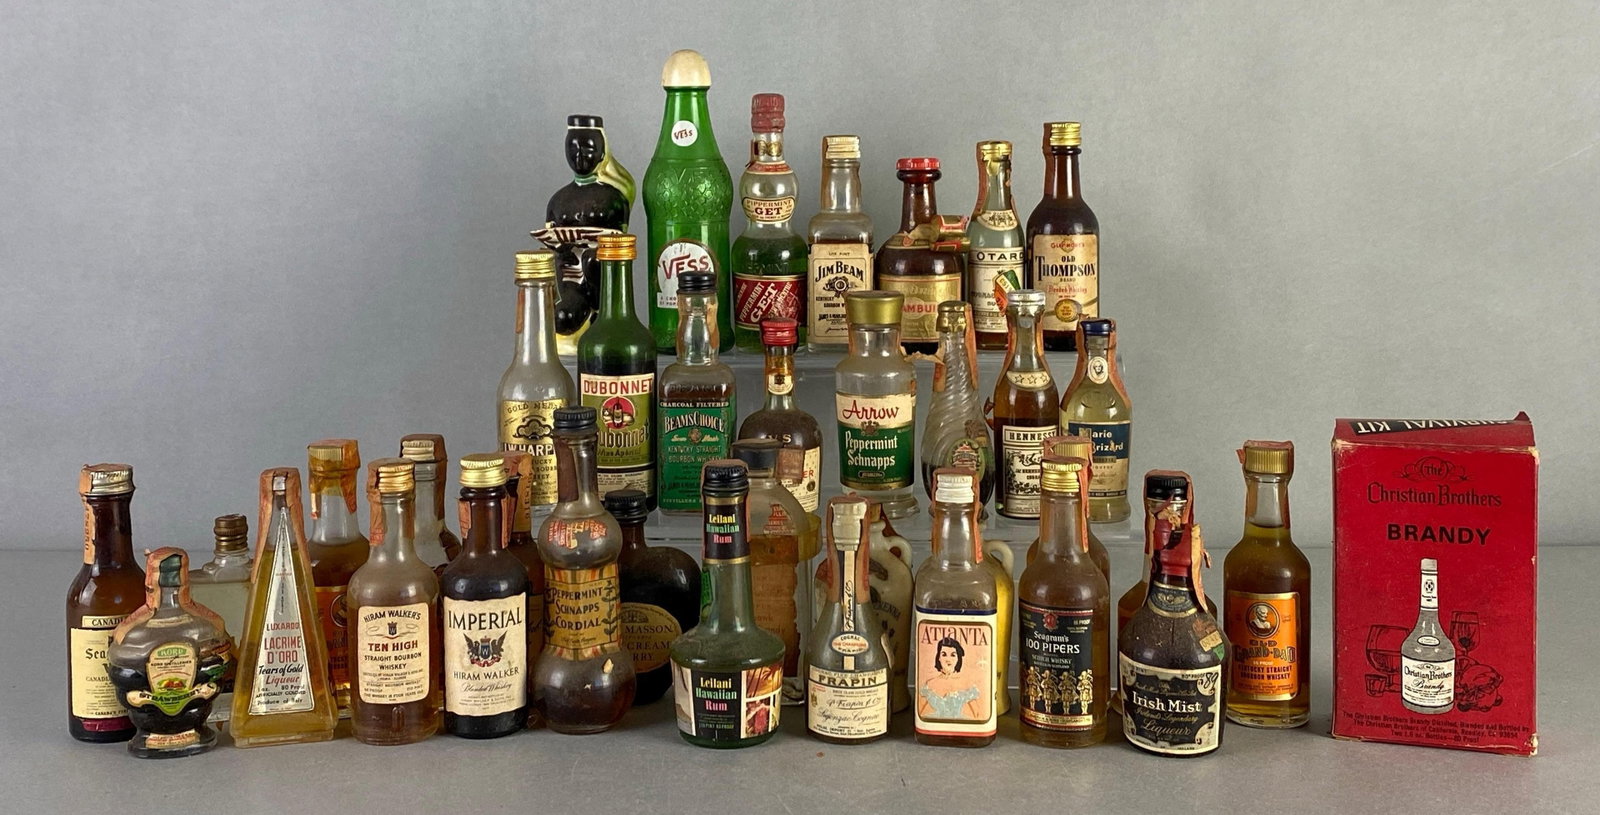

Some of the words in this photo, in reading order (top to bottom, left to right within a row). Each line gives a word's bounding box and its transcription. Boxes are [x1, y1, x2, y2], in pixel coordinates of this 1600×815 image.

[674, 129, 693, 140] VESS
[754, 207, 783, 216] GET
[662, 253, 709, 279] VESS
[815, 265, 834, 282] JIM
[836, 261, 864, 282] BEAM
[1035, 256, 1096, 281] THOMPSON
[751, 283, 778, 322] GET
[902, 304, 936, 313] AMBUI
[584, 378, 652, 394] DUBONNET
[507, 403, 529, 413] GOLD
[843, 400, 899, 419] Arrow
[1358, 421, 1391, 434] KIT
[1398, 419, 1507, 430] VIVAL
[597, 418, 649, 449] ubonnet
[845, 430, 898, 452] Peppermint
[847, 449, 896, 470] Schnapps
[1425, 465, 1443, 476] The
[1368, 482, 1436, 504] Christian
[1438, 485, 1502, 507] Brothers
[709, 514, 736, 523] Leilani
[706, 524, 740, 533] Hawaiian
[1388, 524, 1491, 545] BRANDY
[713, 534, 732, 543] Rum
[552, 586, 603, 601] PEPPERMINT
[555, 600, 600, 615] SCHNAPPS
[92, 618, 122, 626] CANADI
[364, 610, 386, 622] HIRAM
[388, 609, 421, 620] WALKER'S
[448, 607, 522, 631] IMPERIAL
[266, 622, 300, 631] LUXARDO
[555, 616, 601, 630] CORDIAL
[625, 625, 674, 634] MASSON
[1034, 630, 1069, 642] Seagram's
[264, 636, 302, 650] LACRIME
[368, 643, 388, 652] TEN
[392, 640, 418, 651] HIGH
[627, 641, 671, 650] CREAM
[1026, 638, 1039, 650] 100
[1043, 642, 1080, 654] PIPERS
[267, 650, 298, 664] D'ORO
[394, 652, 422, 661] BOURBON
[633, 654, 653, 662] RRY
[259, 665, 278, 675] Tears
[279, 664, 286, 676] of
[287, 664, 304, 673] Gold
[453, 671, 480, 681] HIRAM
[483, 666, 519, 679] WALKER
[1267, 665, 1292, 673] STRAIGHT
[266, 675, 300, 687] Liqueur
[700, 677, 732, 689] Leilani
[818, 675, 877, 687] FRAPIN
[1413, 679, 1445, 694] Brandy
[695, 687, 737, 700] Hawaiian
[705, 700, 728, 711] Rum
[1133, 691, 1165, 711] Irish
[1168, 699, 1202, 713] Mist
[1143, 720, 1191, 736] Liqueur
[1366, 721, 1392, 729] Christian
